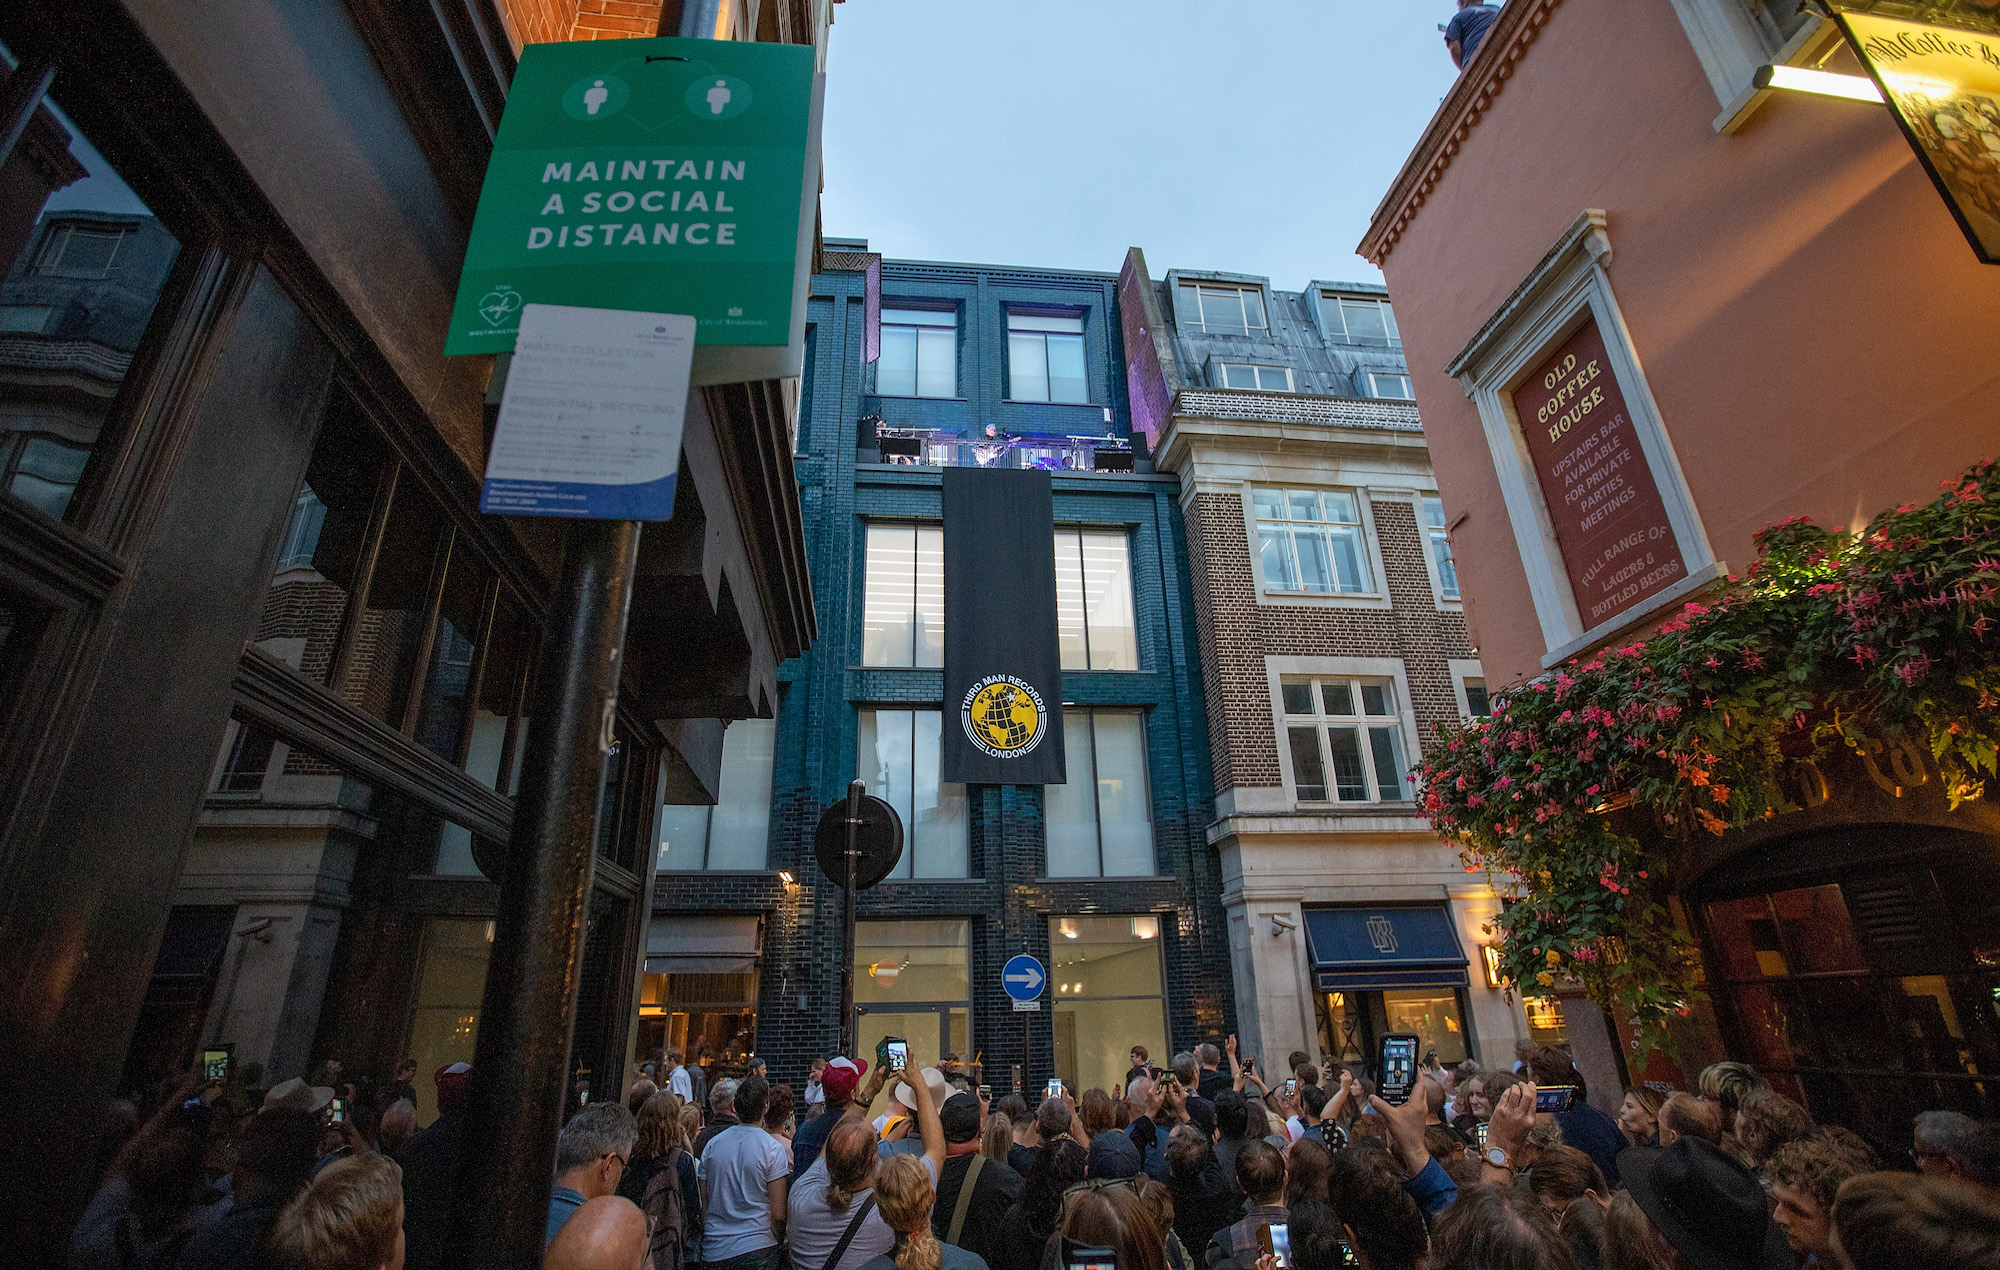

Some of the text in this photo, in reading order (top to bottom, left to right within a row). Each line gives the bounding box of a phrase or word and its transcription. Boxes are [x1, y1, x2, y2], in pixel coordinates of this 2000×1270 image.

[1865, 33, 1908, 65] Old
[1897, 31, 1974, 59] Coffee
[541, 160, 746, 183] MAINTAIN
[541, 191, 734, 215] A SOCIAL
[527, 223, 737, 249] DISTANCE
[1537, 358, 1601, 424] COFFEE
[1543, 353, 1577, 391] OLD
[1547, 385, 1605, 444] HOUSE
[1551, 413, 1625, 478] UPSTAIRS BAR
[1564, 435, 1622, 488] AVAILABLE
[1564, 448, 1632, 506] FOR PRIVATE
[1580, 474, 1624, 512] PARTIES
[1580, 486, 1636, 533] MEETINGS
[1581, 526, 1667, 588] FULL RANGE OF
[1602, 552, 1655, 592] LAGERS &
[1591, 558, 1680, 618] BOTTLED BEERS
[961, 673, 1047, 712] THIRD MAN RECORDS
[984, 745, 1027, 759] LONDON
